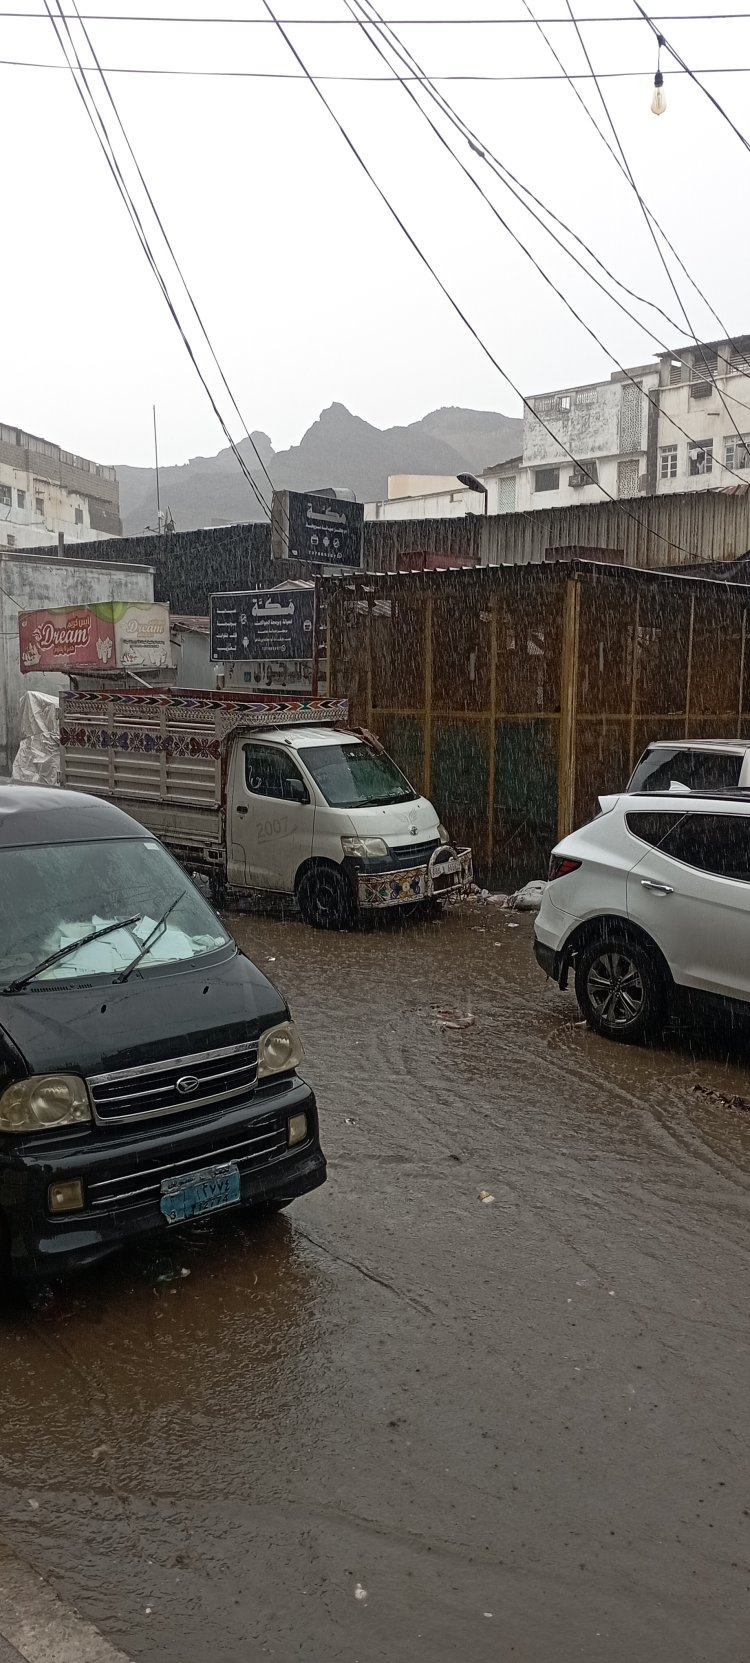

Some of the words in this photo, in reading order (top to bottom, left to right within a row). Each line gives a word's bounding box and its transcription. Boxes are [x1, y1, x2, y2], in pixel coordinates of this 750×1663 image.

[41, 623, 88, 645] Dream
[126, 620, 163, 633] Dream
[256, 816, 288, 839] 2007
